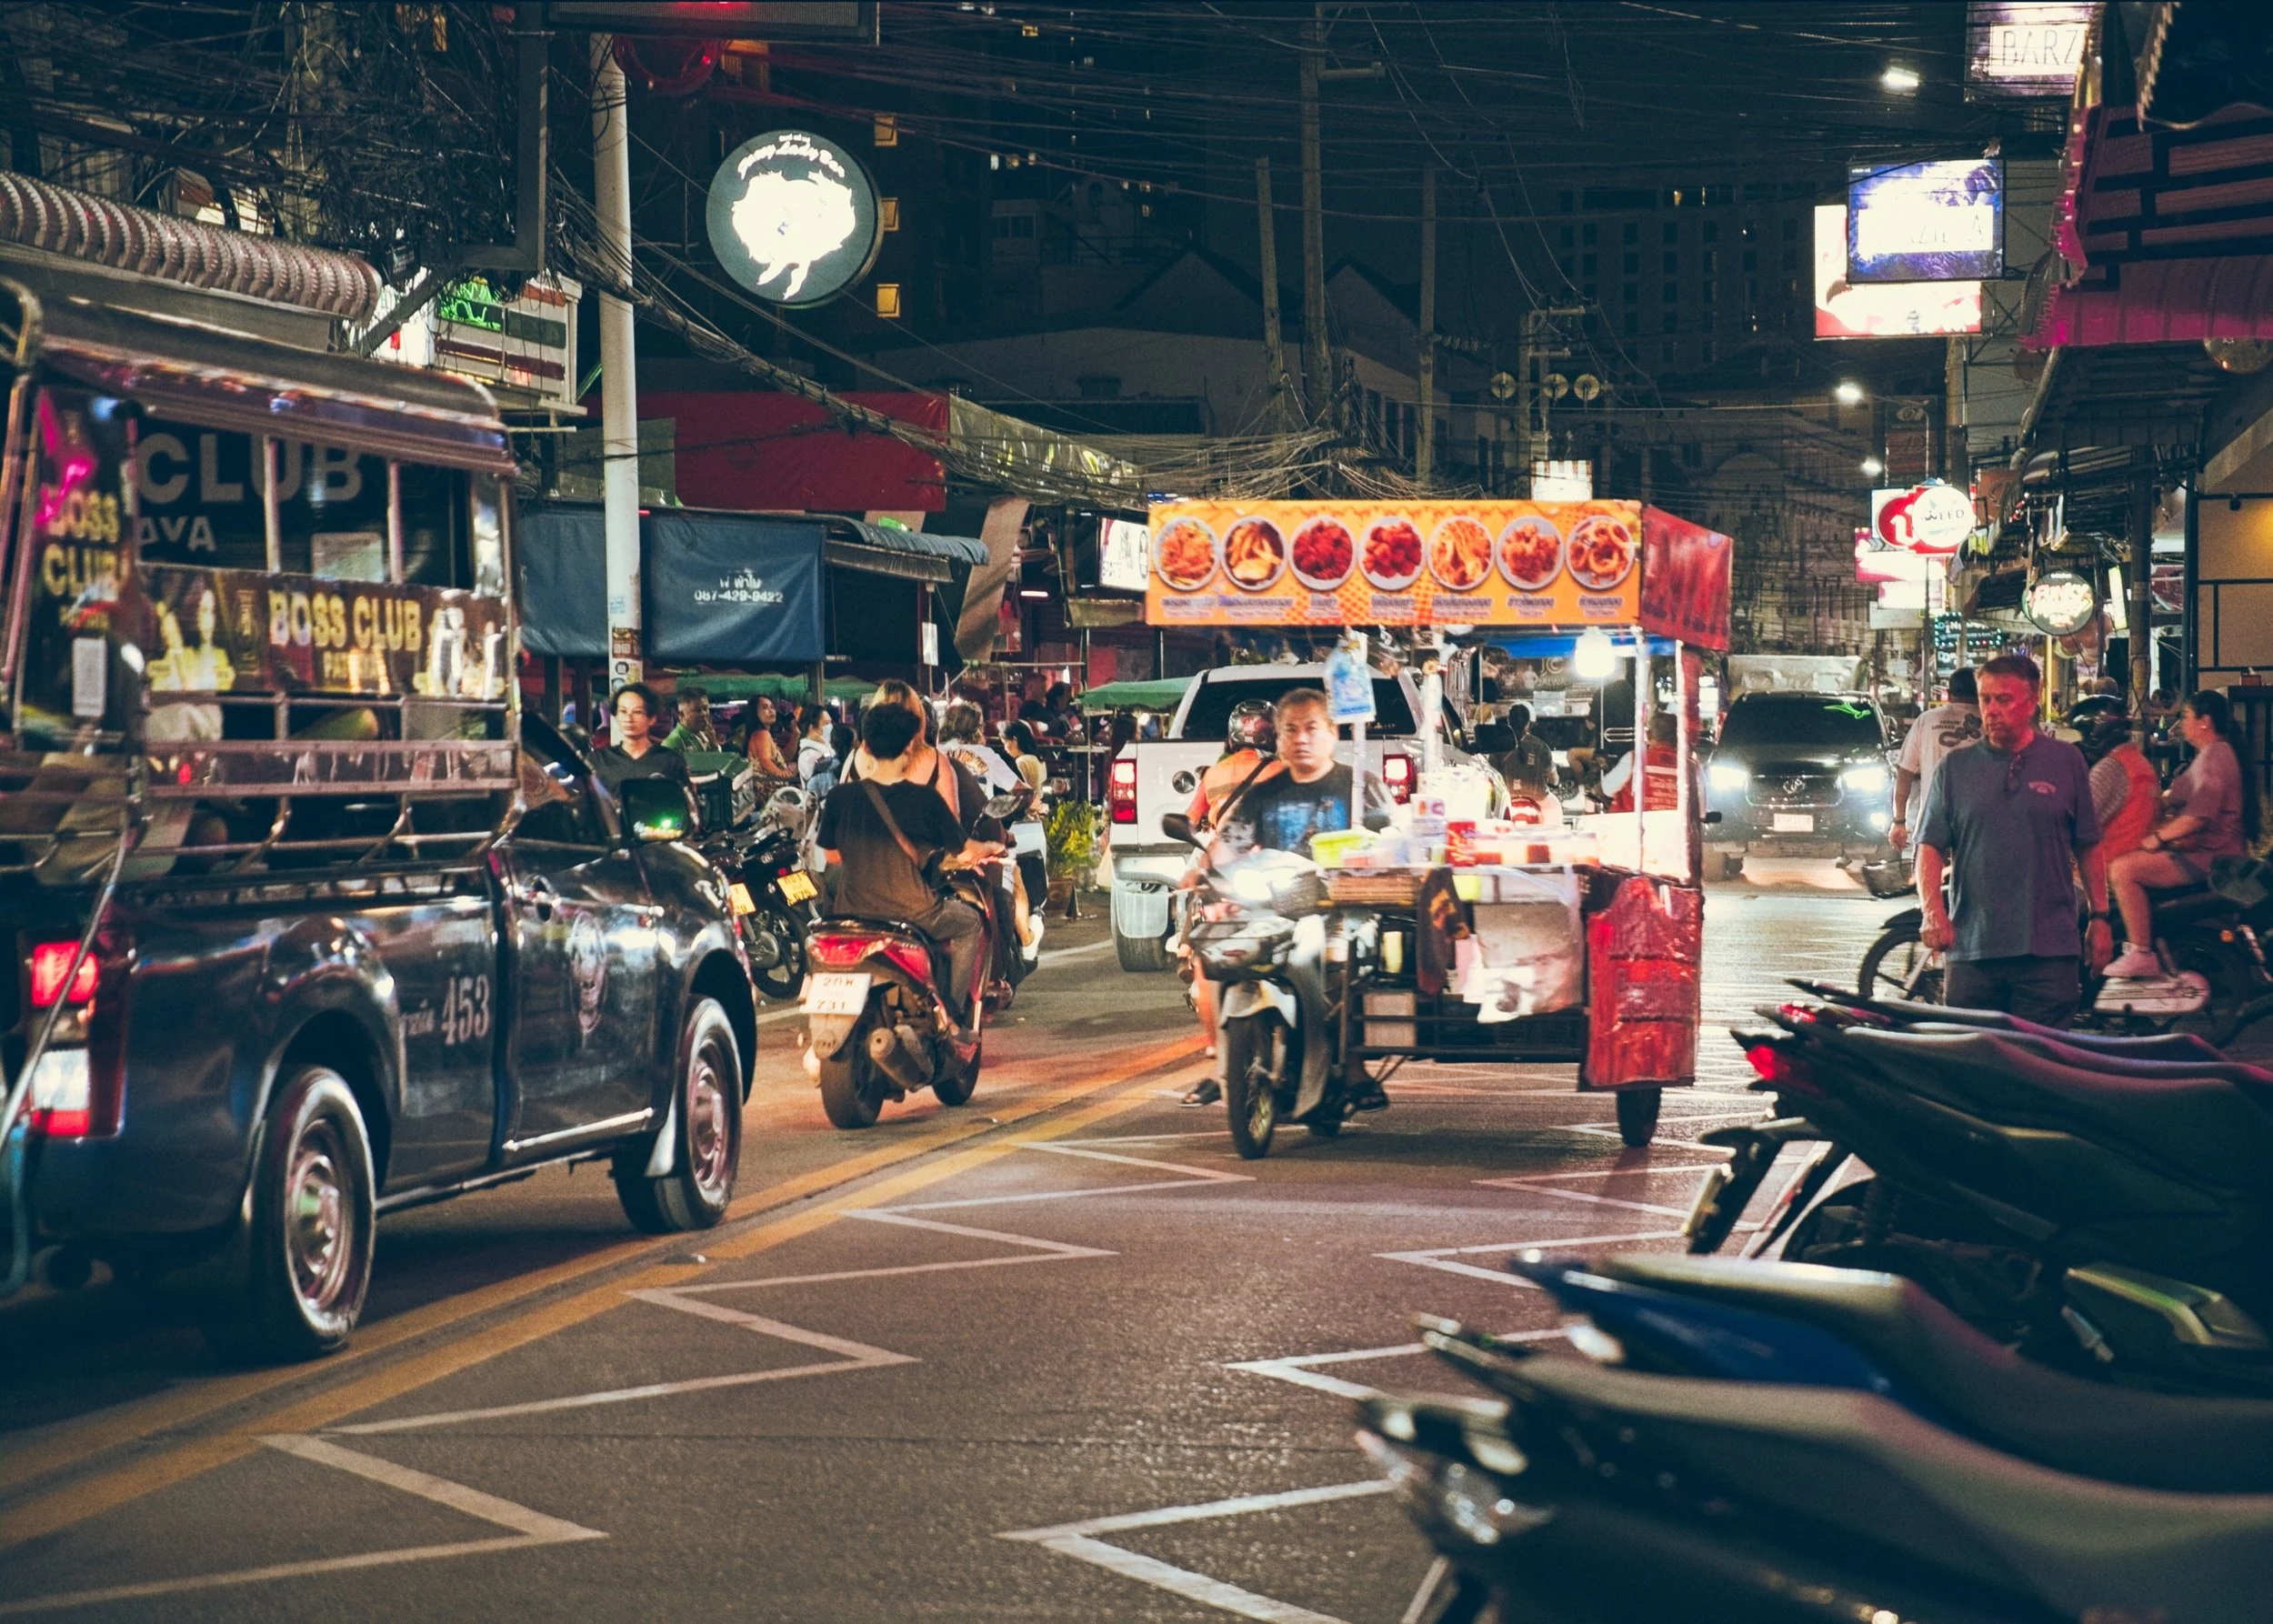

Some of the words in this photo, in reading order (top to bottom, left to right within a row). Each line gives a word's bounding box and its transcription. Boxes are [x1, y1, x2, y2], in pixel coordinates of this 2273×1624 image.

[776, 140, 819, 162] Lady
[137, 433, 362, 503] CLUB
[268, 589, 347, 647] BOSS
[353, 595, 422, 651] CLUB
[440, 974, 490, 1046] 453
